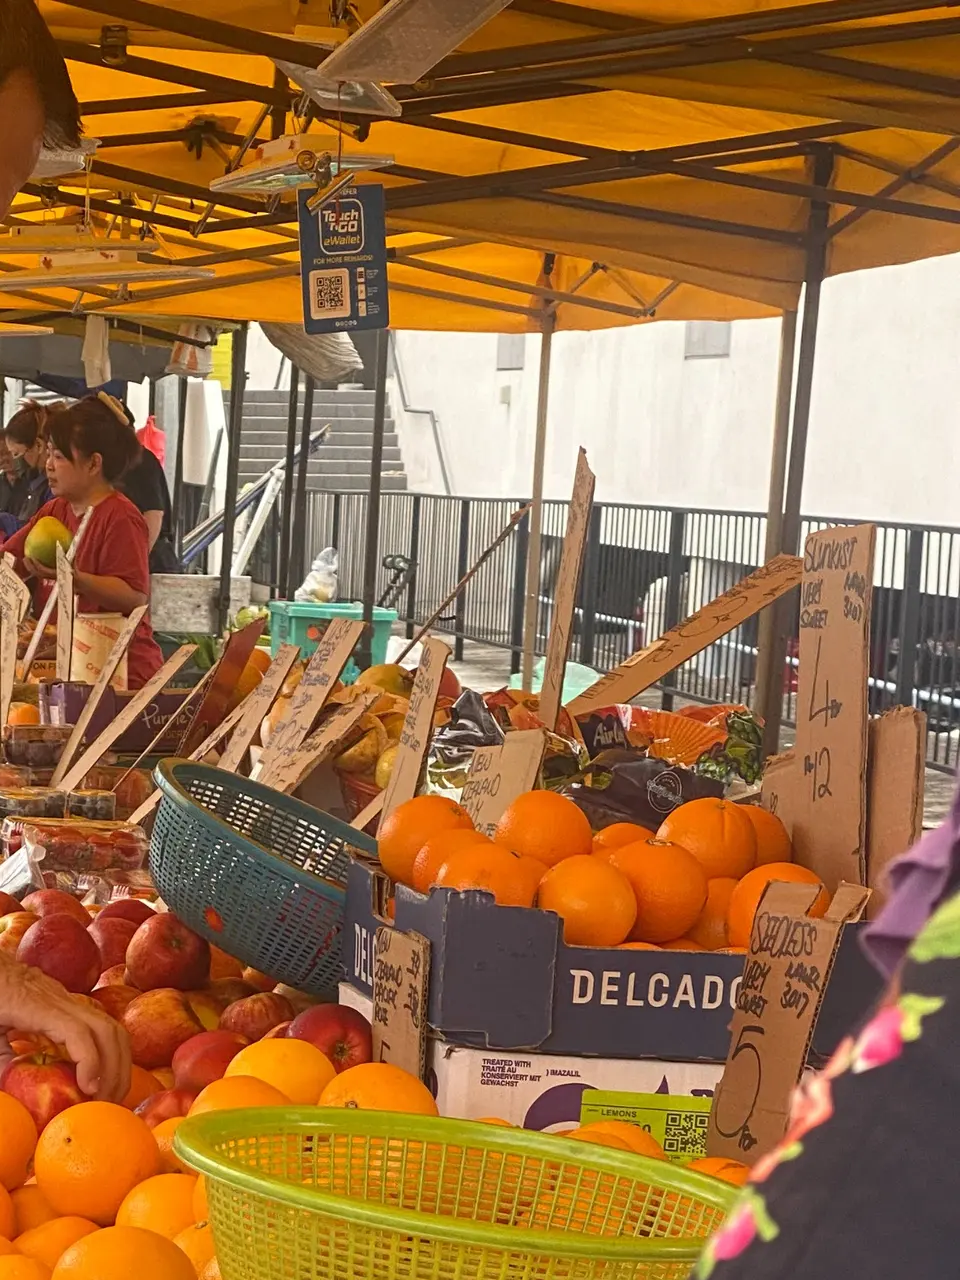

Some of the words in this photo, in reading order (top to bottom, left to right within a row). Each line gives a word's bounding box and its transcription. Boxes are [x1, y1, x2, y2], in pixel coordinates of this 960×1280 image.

[323, 234, 361, 246] eWallet
[313, 257, 326, 265] FOR
[326, 256, 343, 264] MORE
[482, 1058, 514, 1067] TREATED
[514, 1060, 532, 1068] WITH
[506, 1066, 517, 1074] AU
[549, 1069, 581, 1077] IMAZALIL
[481, 1072, 529, 1082] KONSERVIERT
[480, 1079, 519, 1087] GEWACHST
[601, 1108, 637, 1118] LEMONS
